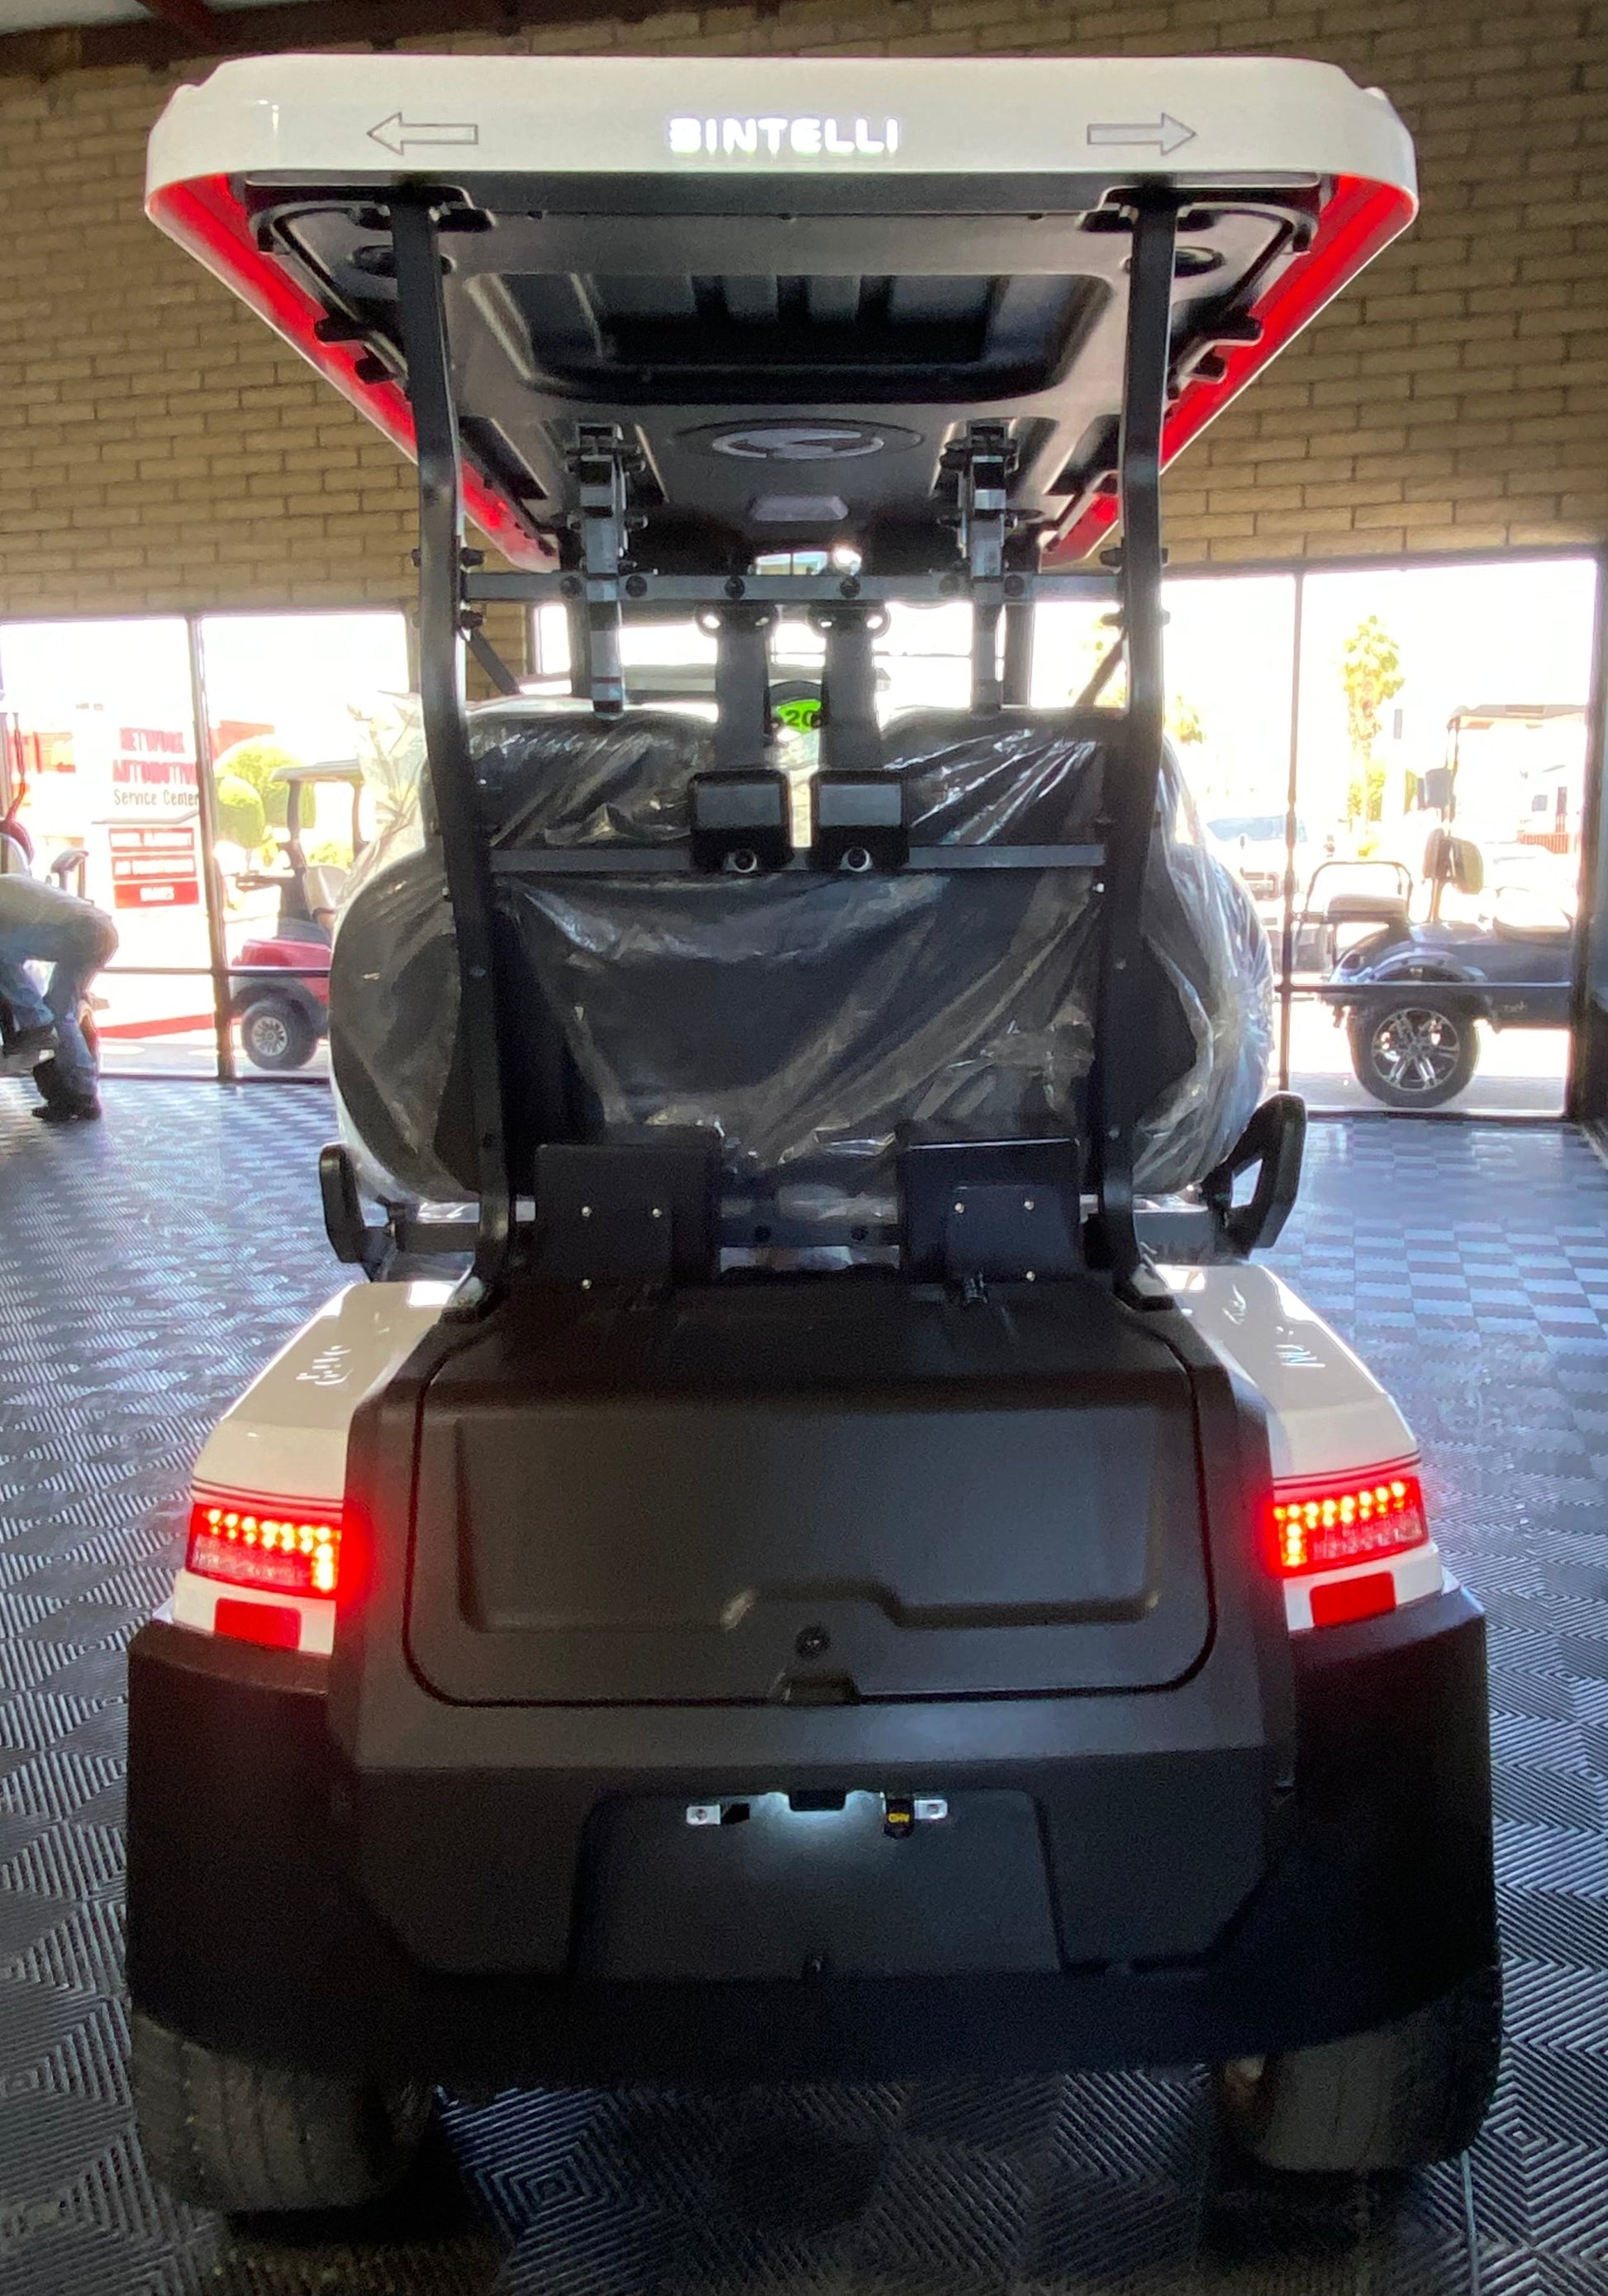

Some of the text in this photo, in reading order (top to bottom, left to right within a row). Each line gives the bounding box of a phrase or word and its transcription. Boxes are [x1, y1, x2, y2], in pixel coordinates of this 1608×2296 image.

[668, 116, 899, 157] BINTELLI
[114, 788, 199, 806] Service Center
